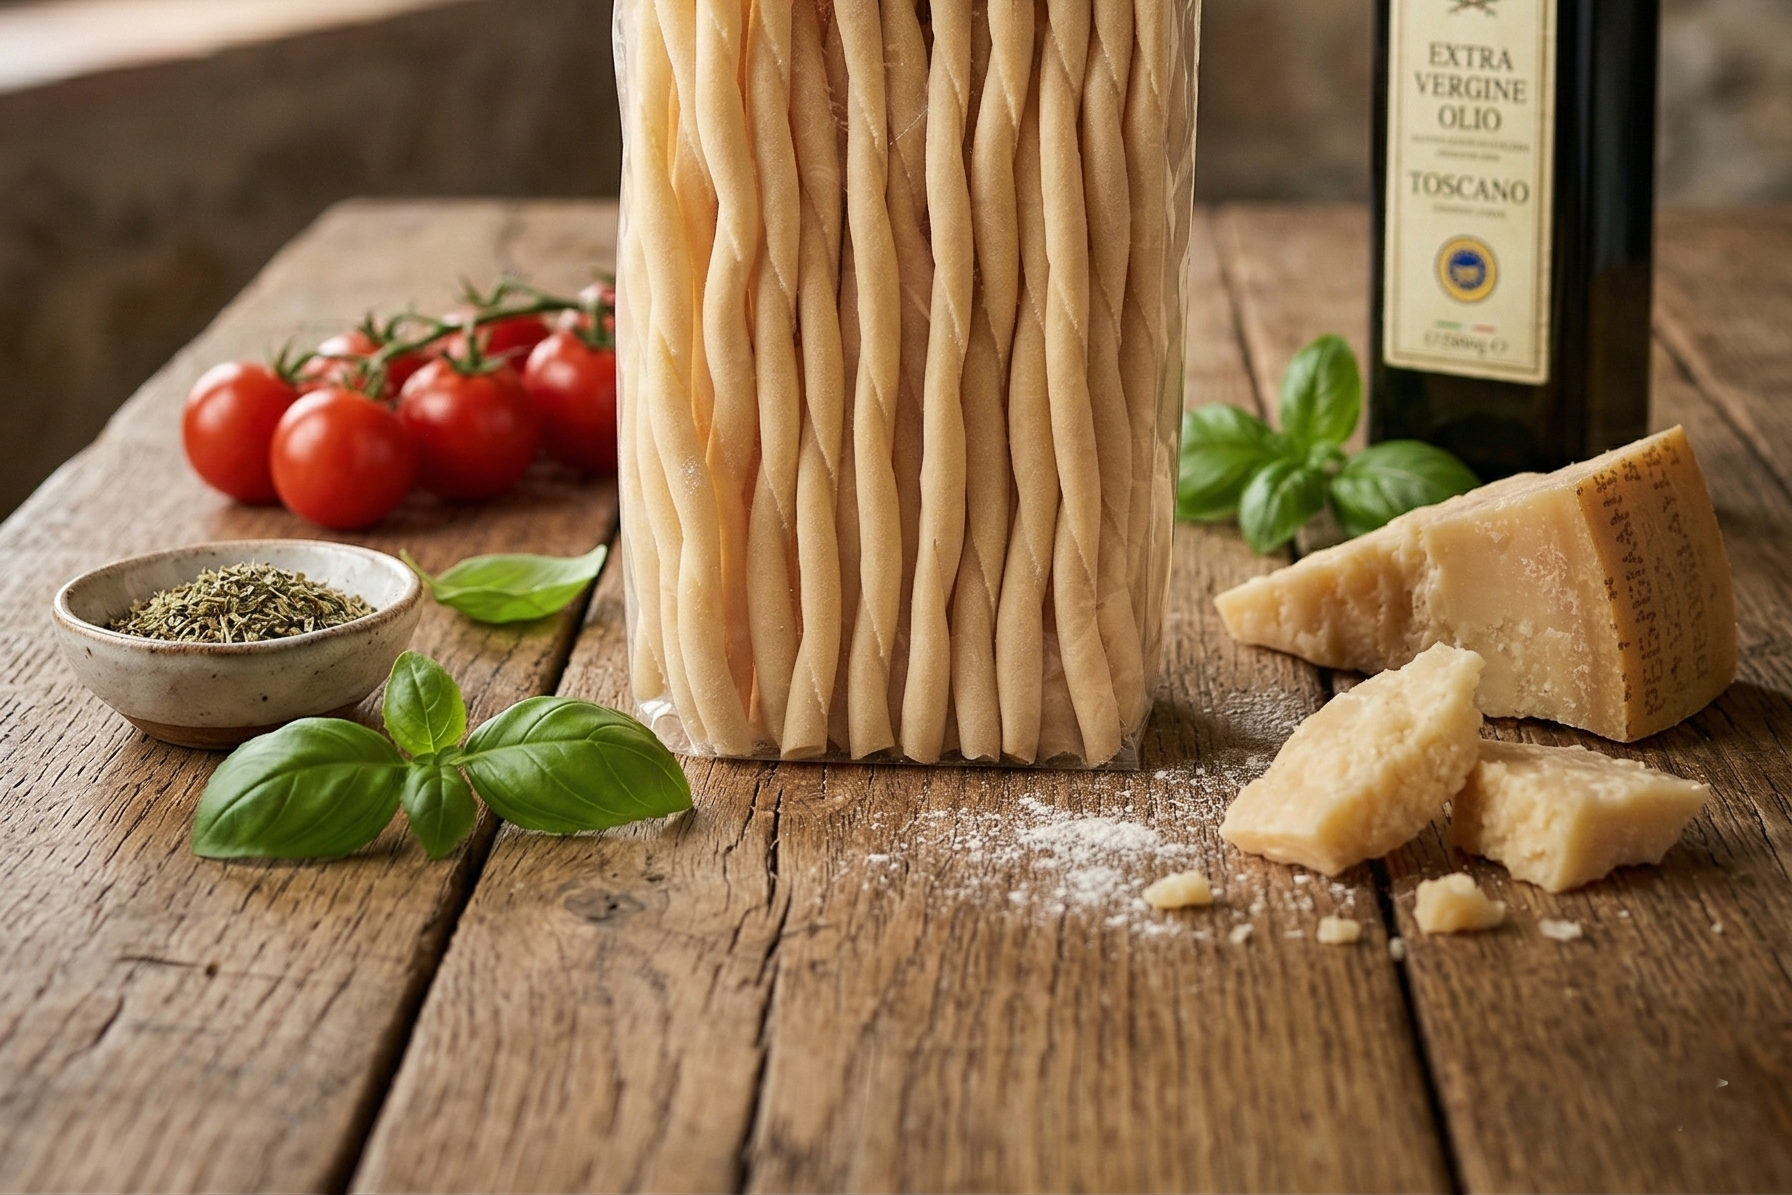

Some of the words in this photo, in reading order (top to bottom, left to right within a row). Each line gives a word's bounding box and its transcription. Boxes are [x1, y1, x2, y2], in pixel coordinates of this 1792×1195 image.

[1429, 42, 1513, 72] EXTRA
[1414, 72, 1527, 104] VERGINE
[1438, 104, 1502, 132] OLIO
[1408, 170, 1530, 206] TOSCANO
